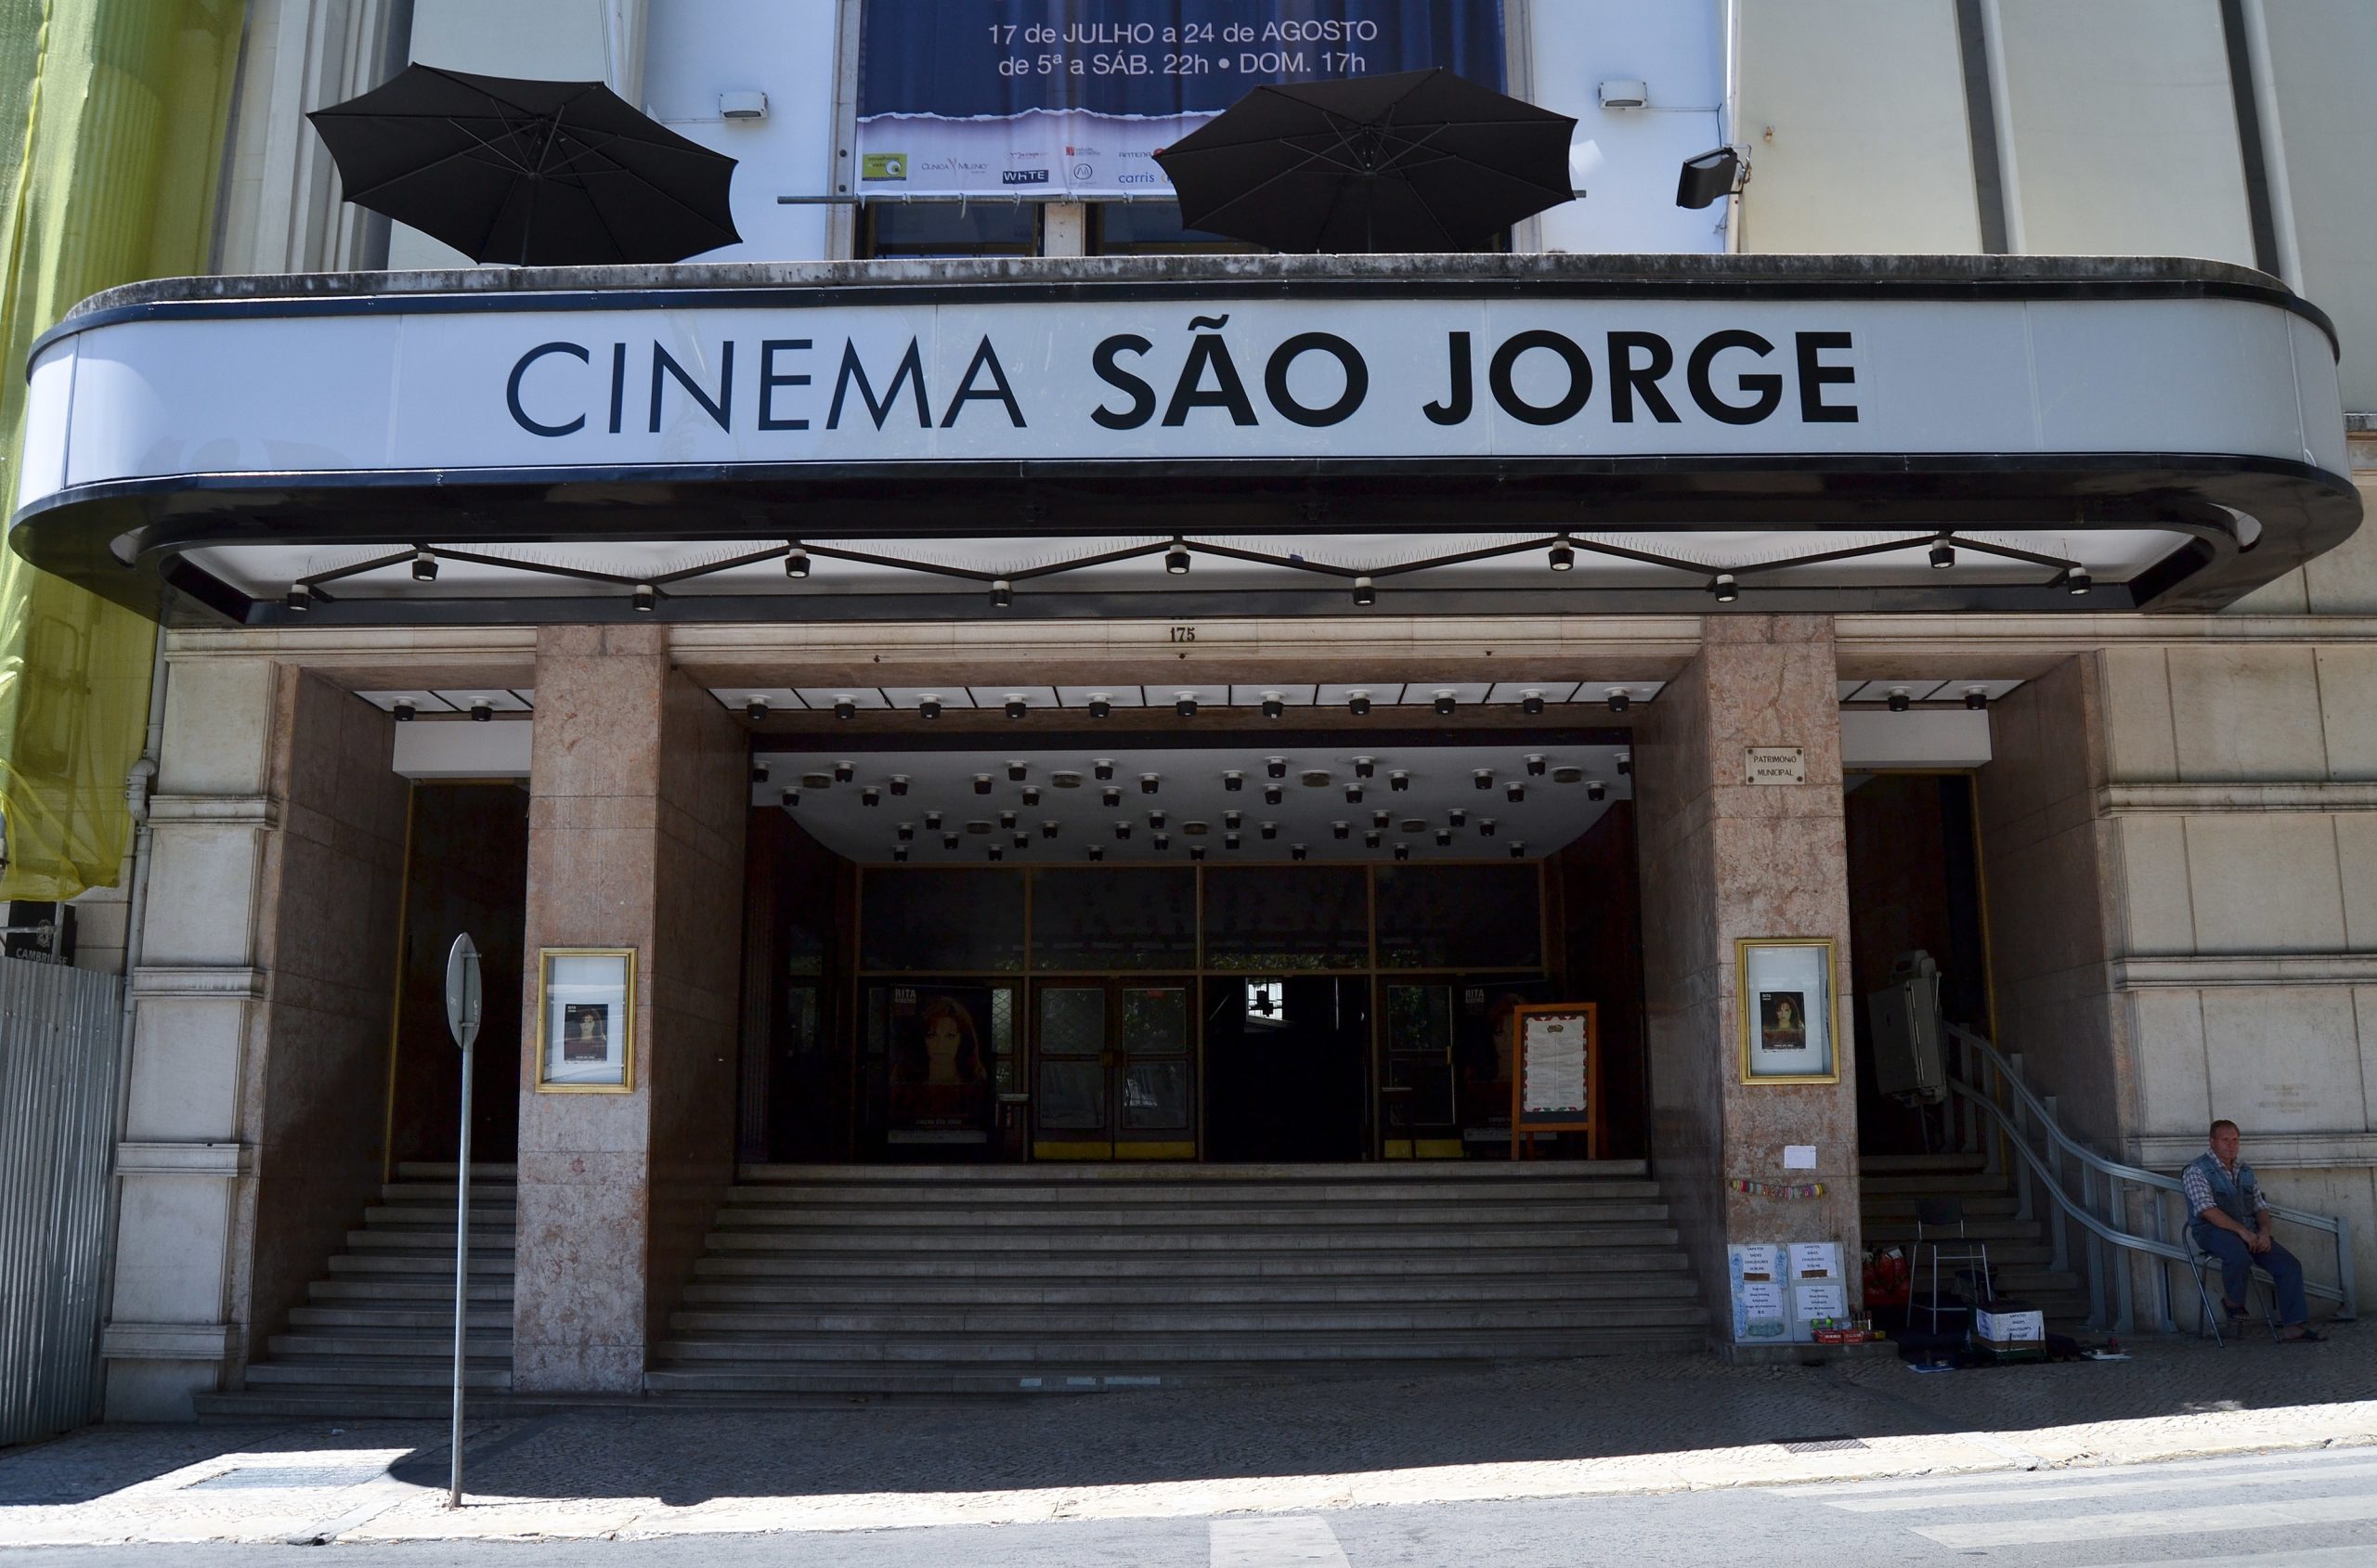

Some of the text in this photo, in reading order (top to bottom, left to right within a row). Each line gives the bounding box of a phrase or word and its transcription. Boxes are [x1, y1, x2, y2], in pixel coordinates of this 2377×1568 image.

[988, 19, 1378, 45] 17 de JULHO a 24 de AGOSTO
[998, 49, 1366, 76] de 5ª a SÁB. 22h DOM. 17h
[1118, 172, 1155, 184] carris
[506, 314, 1860, 437] CINEMA SÃO JORGE
[1170, 627, 1196, 642] 175
[16, 947, 68, 965] CAMBRIE
[895, 989, 916, 998] RITA
[1465, 989, 1485, 998] RITA
